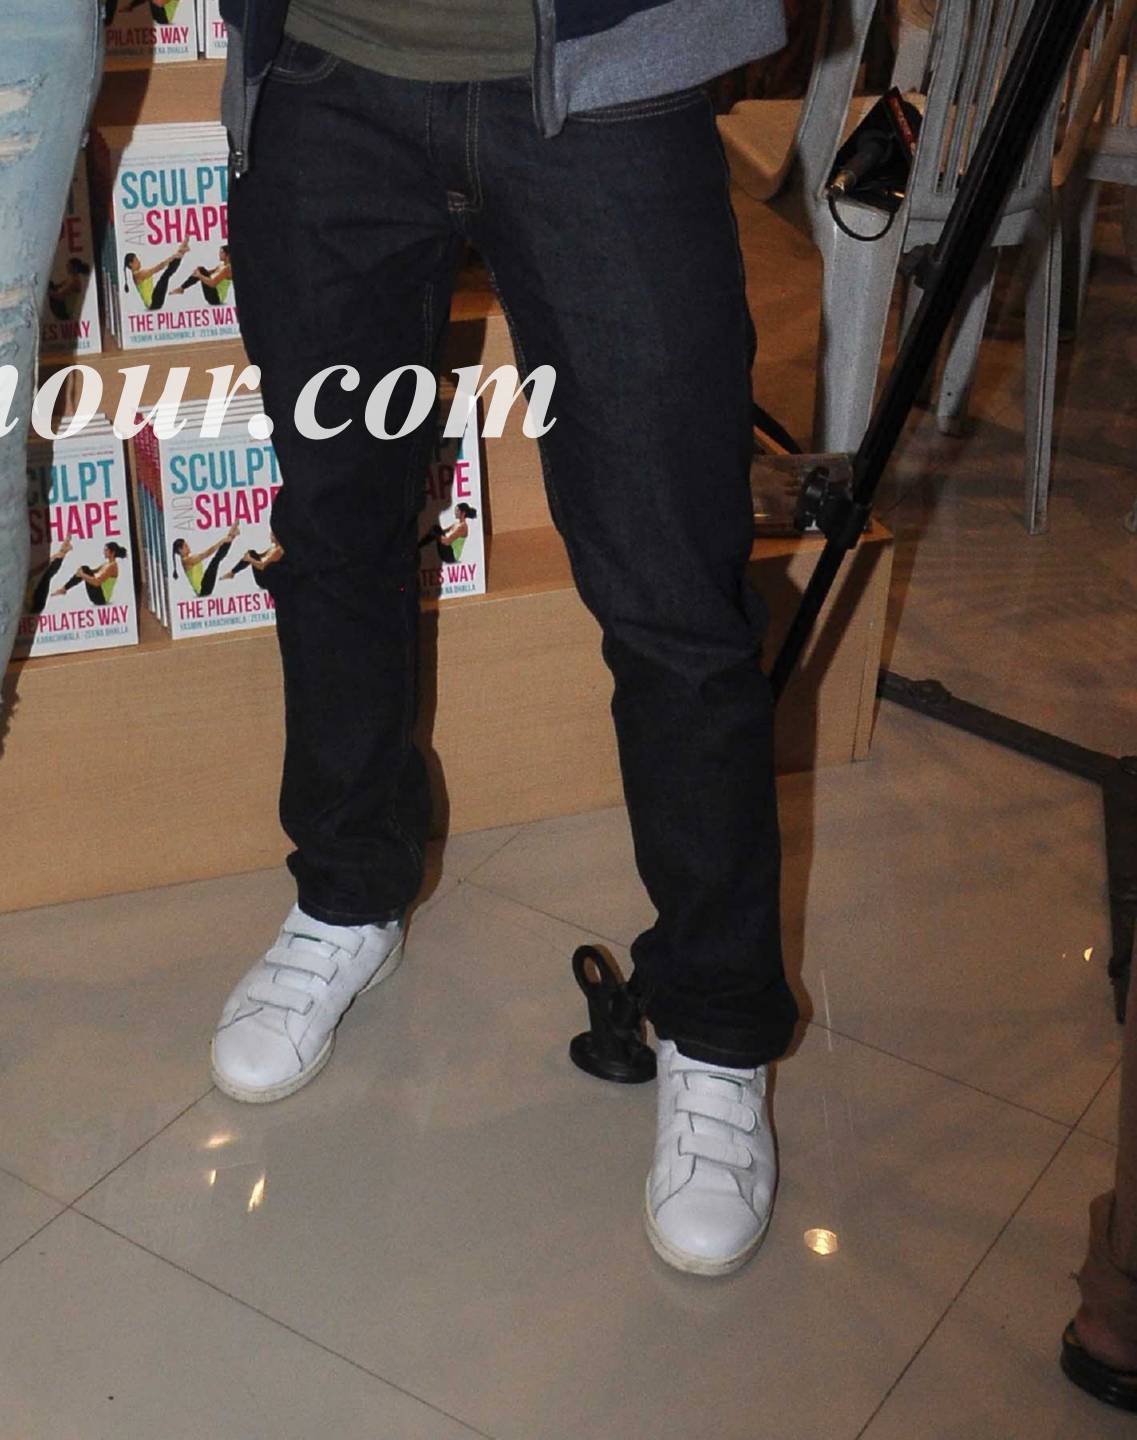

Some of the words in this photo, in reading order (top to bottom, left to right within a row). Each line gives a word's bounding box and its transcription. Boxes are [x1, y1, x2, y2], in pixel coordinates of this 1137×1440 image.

[106, 27, 158, 47] PILATES
[160, 26, 190, 45] WAY
[212, 22, 228, 39] TH
[121, 165, 229, 210] SCULPT
[123, 211, 145, 247] AND
[128, 314, 154, 332] THE
[157, 308, 210, 330] PILATES
[169, 446, 279, 495] SCULPT
[29, 500, 121, 546] SHAPE
[172, 496, 194, 532] AND
[447, 563, 477, 584] WAY
[38, 609, 95, 633] PILATES
[97, 605, 129, 626] WAY
[177, 601, 204, 620] THE
[207, 593, 261, 618] PILATES
